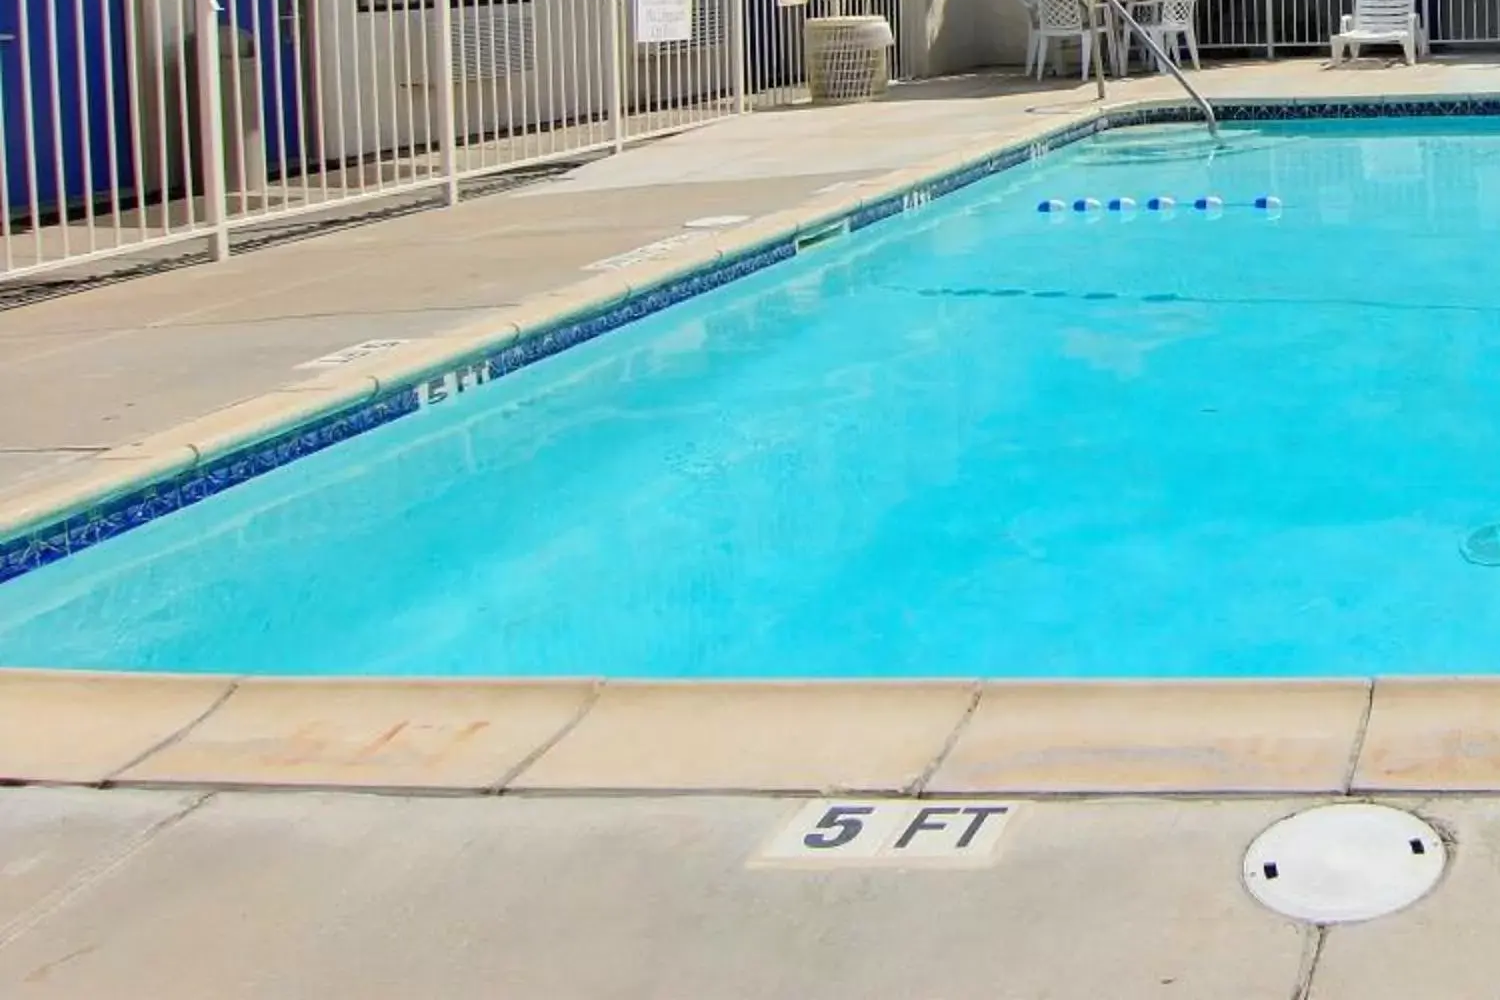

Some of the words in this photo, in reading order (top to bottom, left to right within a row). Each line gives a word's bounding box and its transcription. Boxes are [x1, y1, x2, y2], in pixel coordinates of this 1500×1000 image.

[427, 376, 449, 405] 5
[803, 806, 875, 849] 5
[894, 806, 1009, 849] FT
